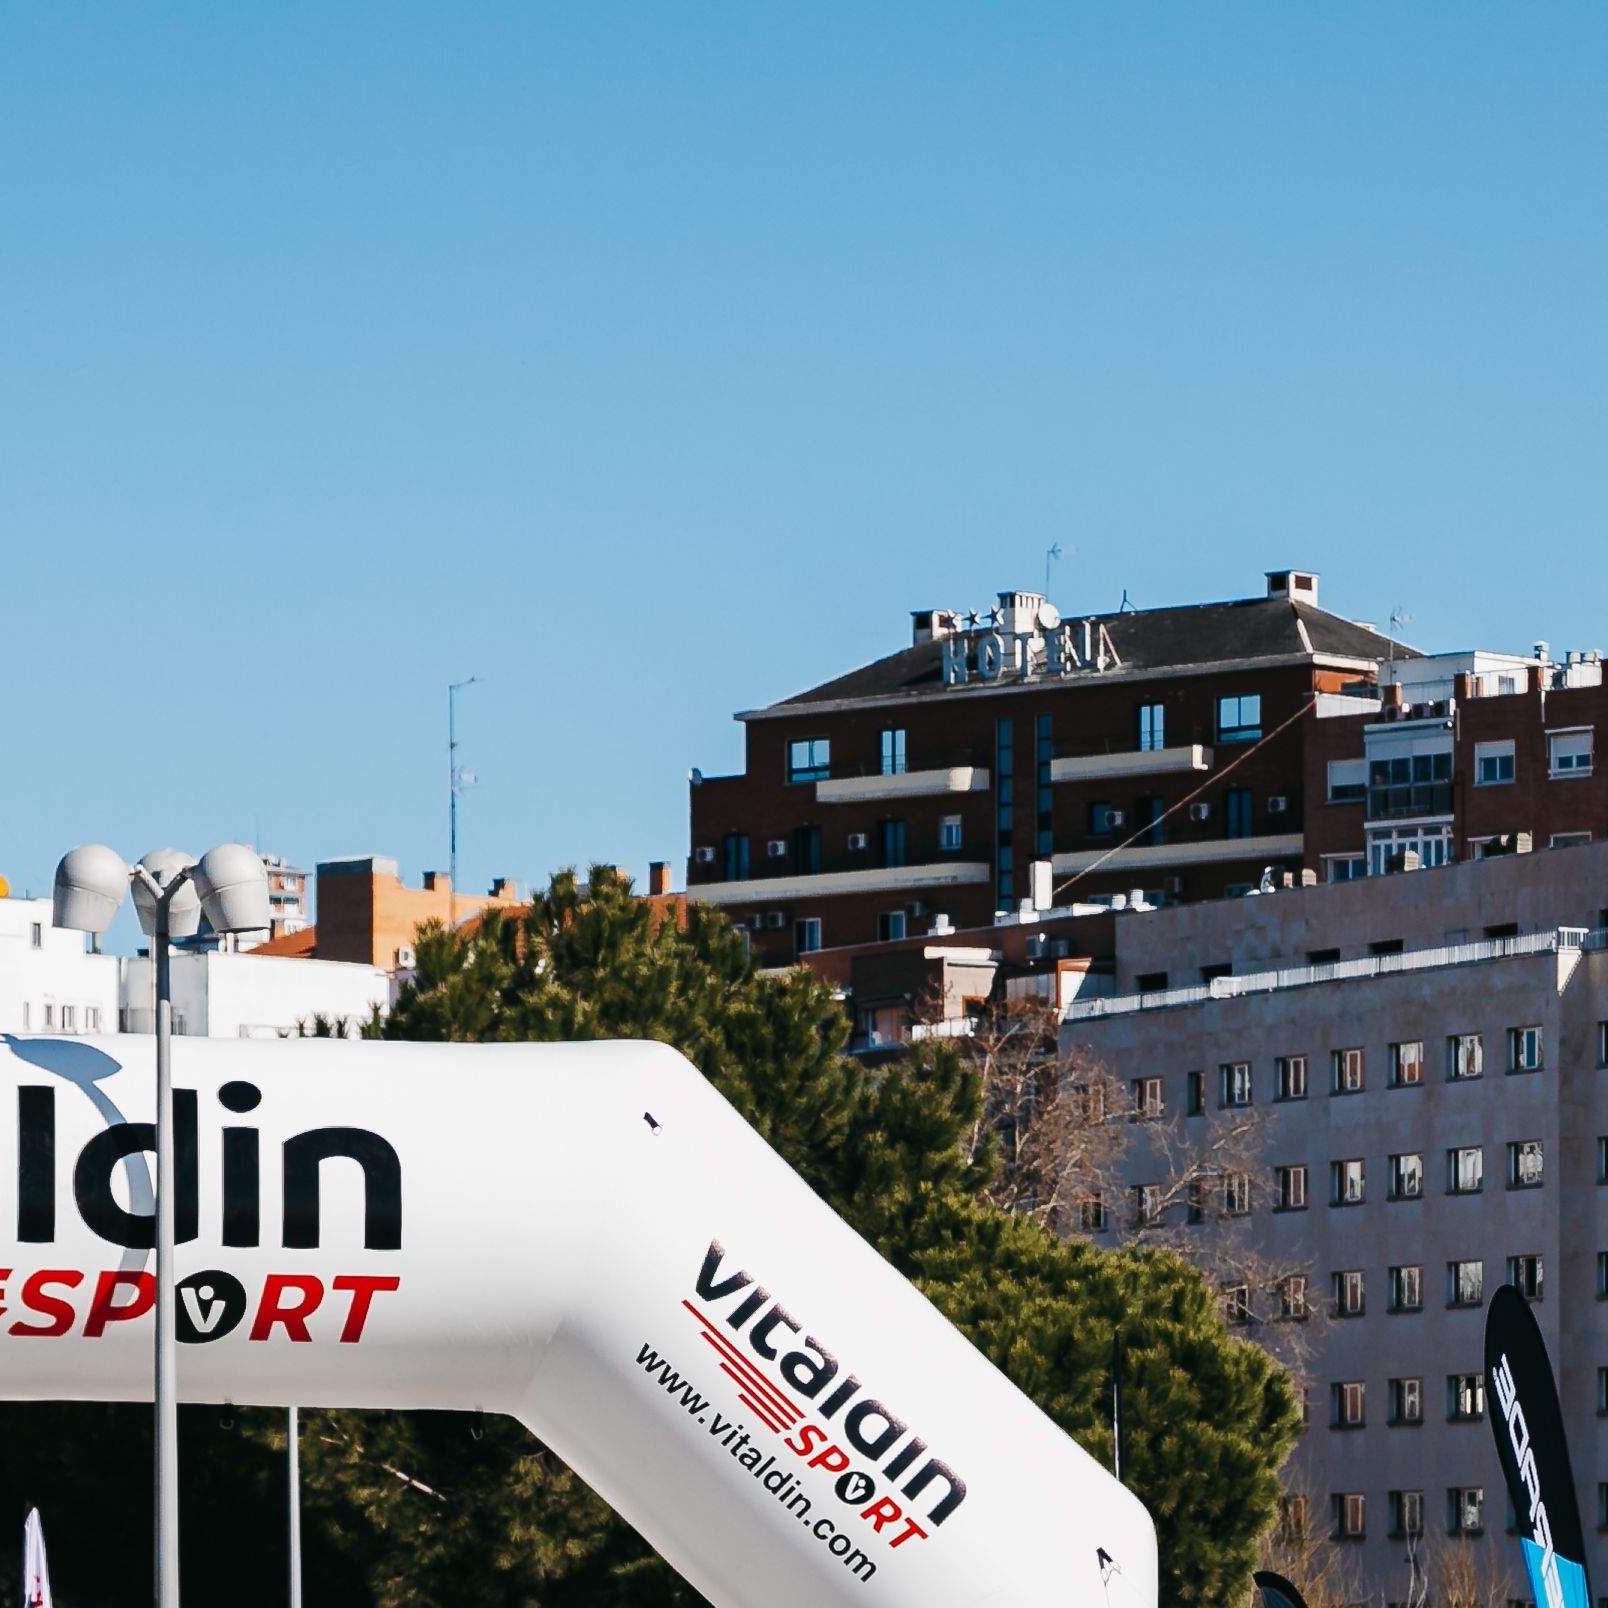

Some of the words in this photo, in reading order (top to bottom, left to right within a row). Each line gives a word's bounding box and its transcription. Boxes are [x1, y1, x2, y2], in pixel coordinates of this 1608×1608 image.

[7, 1268, 402, 1346] SPORT
[634, 1341, 879, 1584] www.vitaldin.com
[783, 1423, 929, 1552] SPORT
